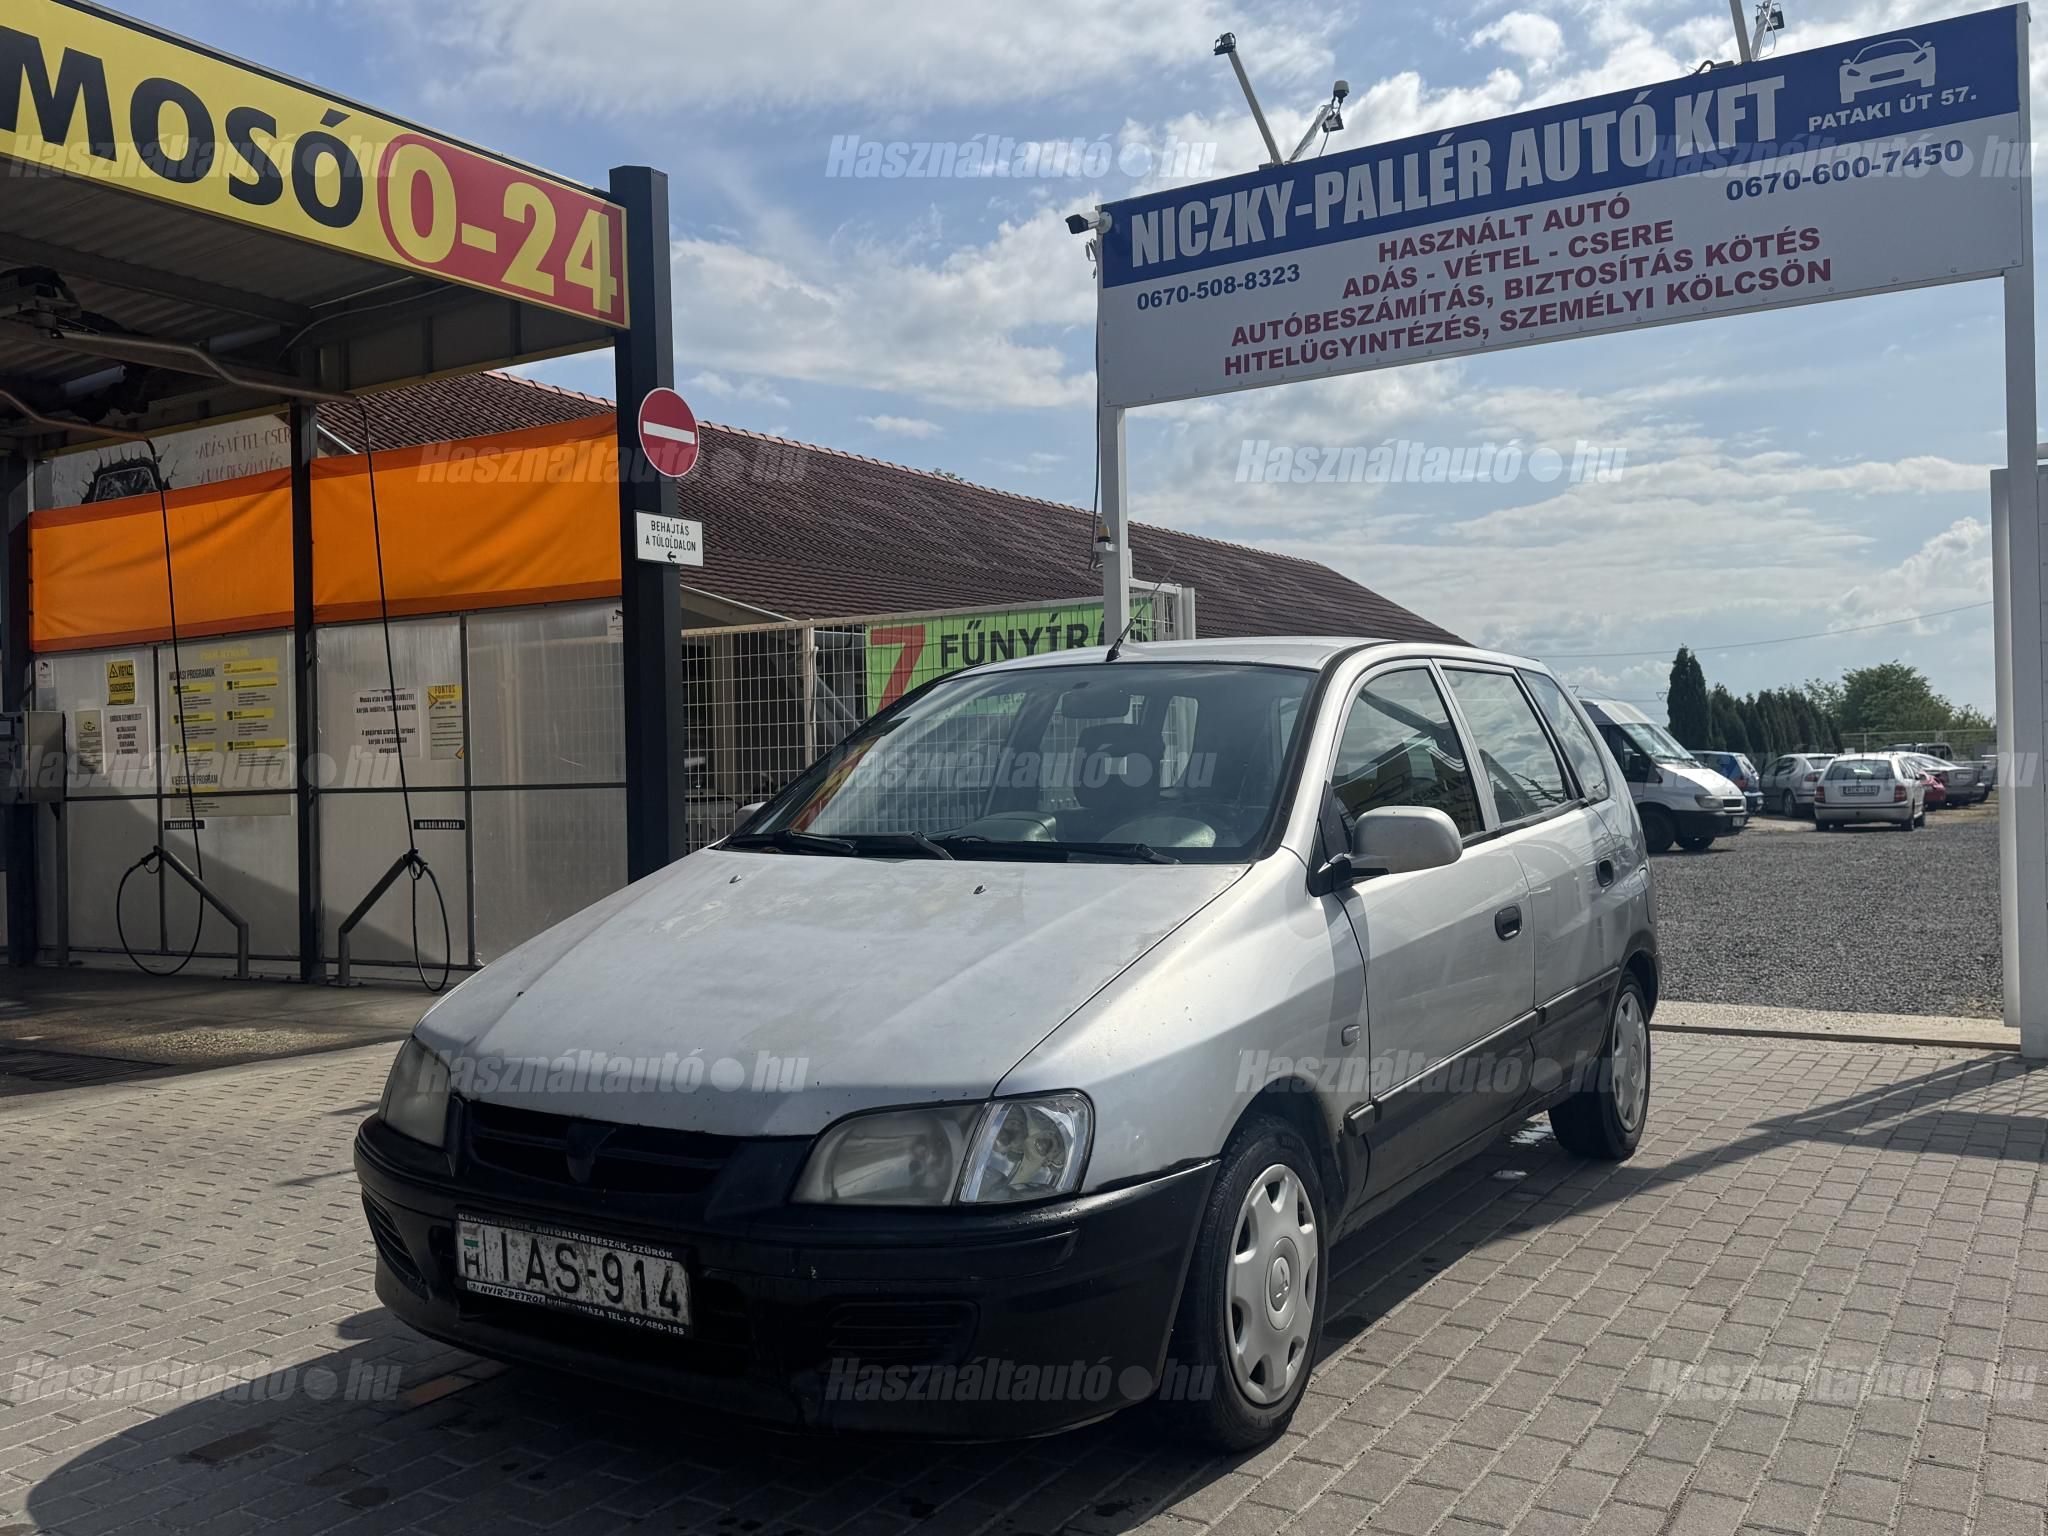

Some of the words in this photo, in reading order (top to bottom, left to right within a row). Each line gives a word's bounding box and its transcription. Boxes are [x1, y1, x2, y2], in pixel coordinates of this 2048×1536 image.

[0, 25, 364, 228] MOSÓ
[1808, 104, 1891, 132] PATAKI
[1899, 89, 1933, 114] ÚT
[1941, 86, 1977, 105] 57.
[1131, 132, 1492, 268] NICZKY-PALLÉR
[1506, 91, 1657, 190] AUTÓ
[1675, 76, 1785, 157] KFT
[1725, 140, 1964, 200] 0670-600-7450
[397, 144, 617, 314] 0-24
[1343, 265, 1418, 299] ADÁS
[1446, 241, 1539, 280] VÉTEL
[1568, 220, 1673, 259] CSERE
[1379, 214, 1533, 262] HASZNÁLT
[1543, 193, 1630, 231] AUTÓ
[1137, 264, 1300, 311] 0670-508-8323
[1224, 314, 1490, 376] HITELÜGYINTÉZÉS,
[1500, 288, 1654, 331] SZEMÉLYI
[1667, 258, 1831, 305] KÖLCSÖN
[1231, 278, 1493, 347] AUTÓBESZÁMÍTÁS,
[1505, 242, 1693, 300] BIZTOSÍTÁS
[1705, 227, 1820, 267] KÖTÉS
[646, 535, 650, 546] A
[652, 534, 696, 552] TÚLOLDALON
[651, 520, 689, 536] BEHAJTÁS
[169, 669, 186, 681] MOÁSI
[870, 622, 926, 712] 7
[480, 1285, 544, 1305] NYÍR-PETROL
[501, 1232, 681, 1318] IAS-914
